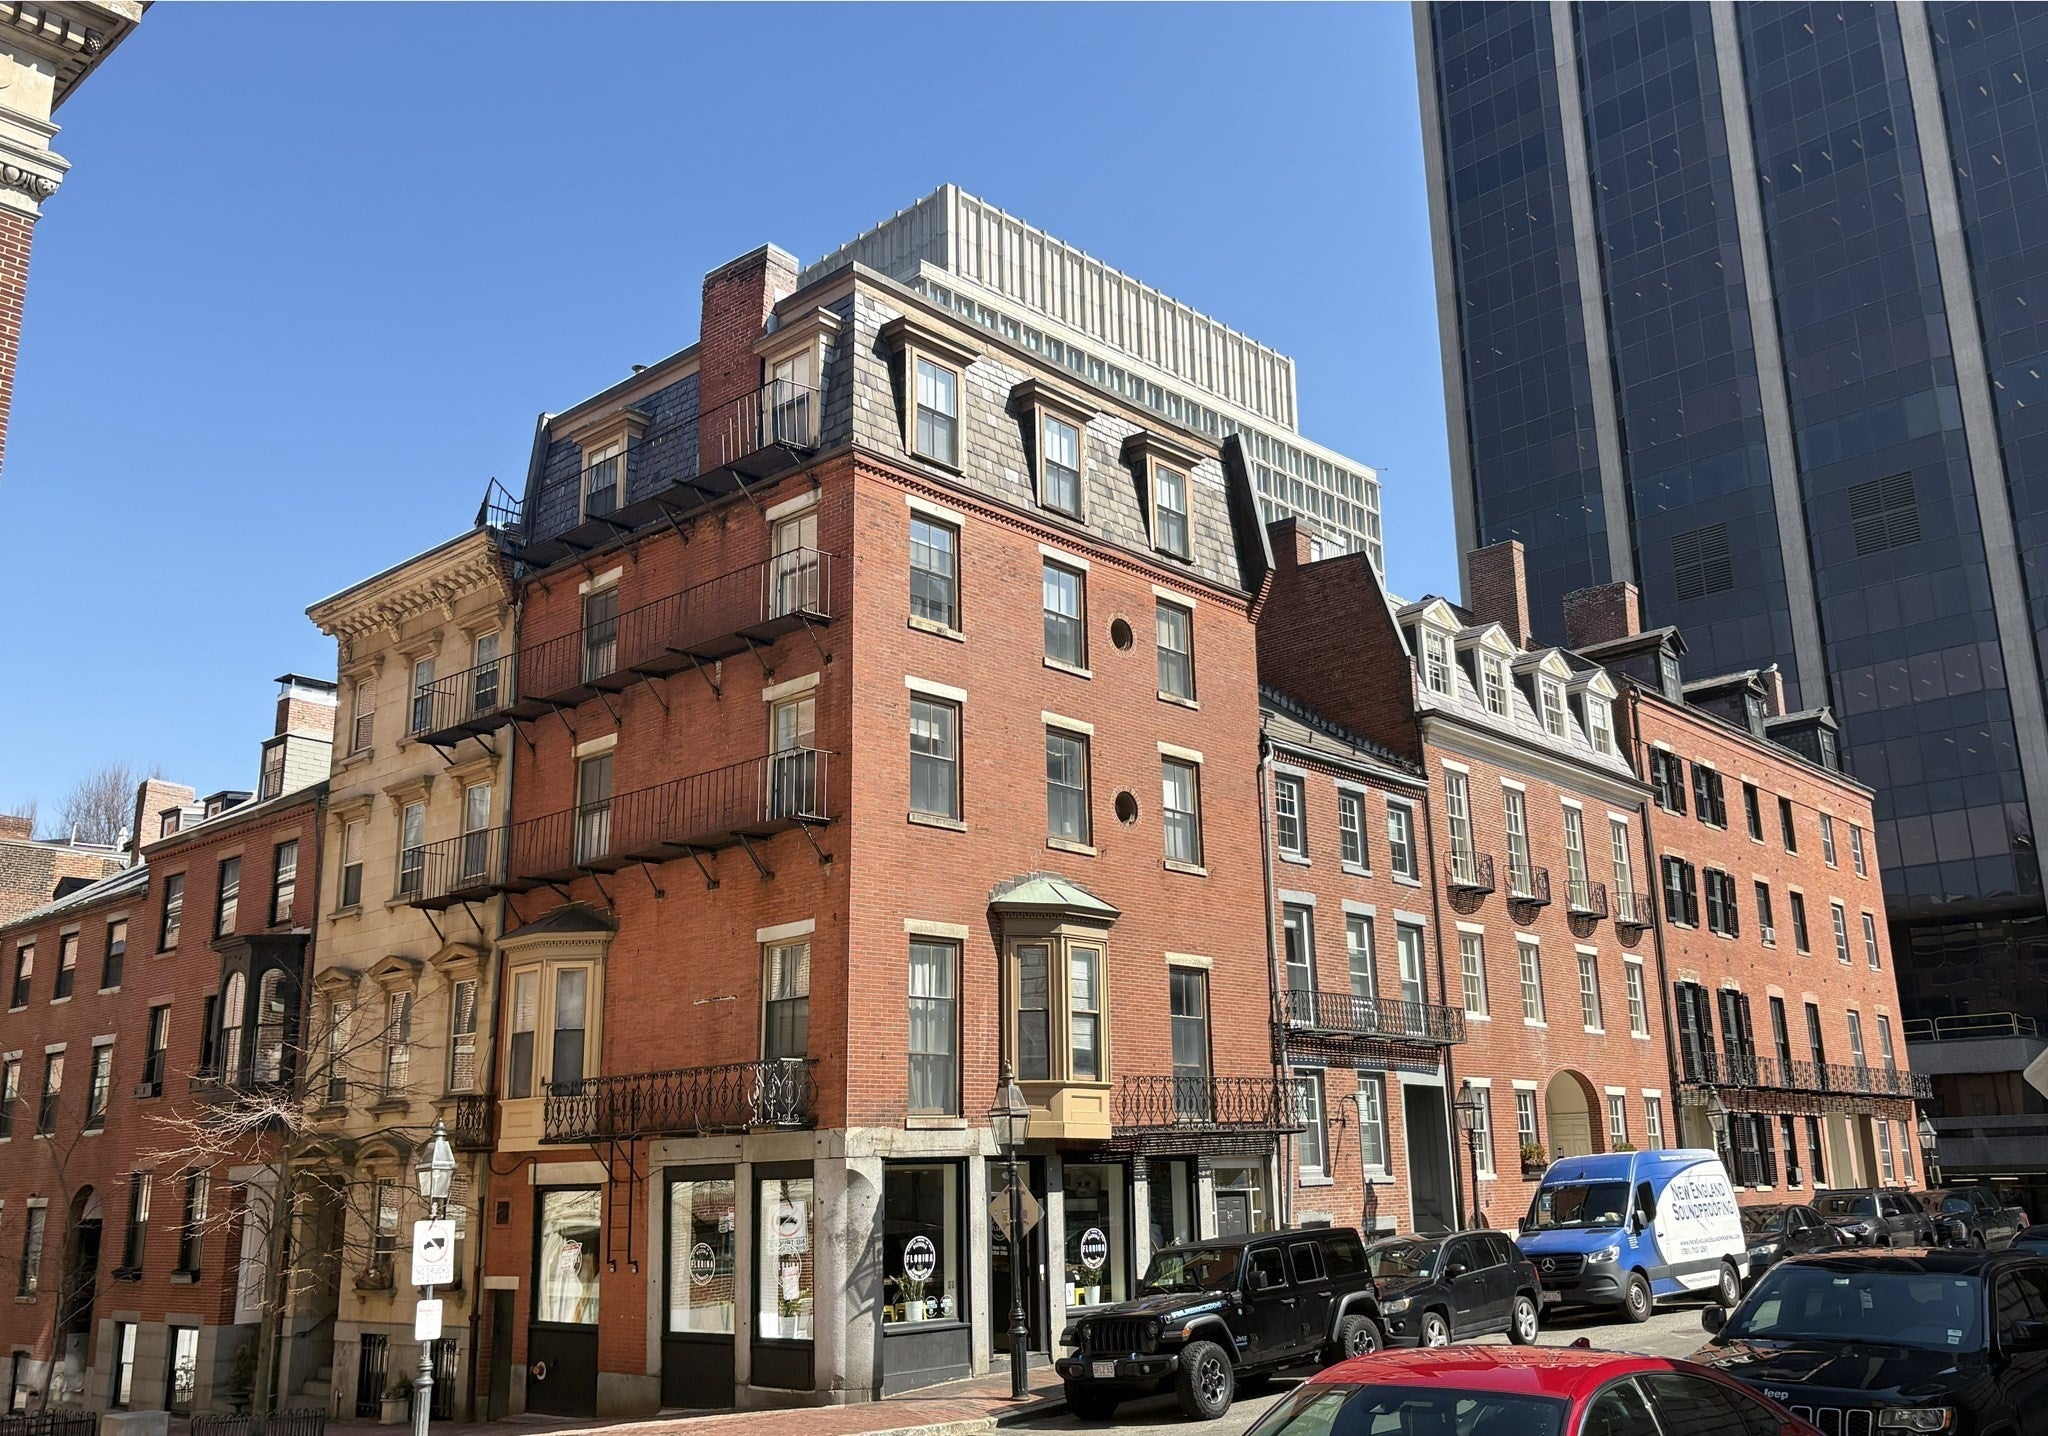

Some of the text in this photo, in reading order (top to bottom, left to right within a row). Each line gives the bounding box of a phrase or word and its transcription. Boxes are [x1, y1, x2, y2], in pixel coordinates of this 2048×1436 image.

[1670, 1182, 1725, 1201] NEW ENGLAND
[1672, 1200, 1734, 1221] SOUNDPROOFING
[1765, 1388, 1789, 1400] Jeep
